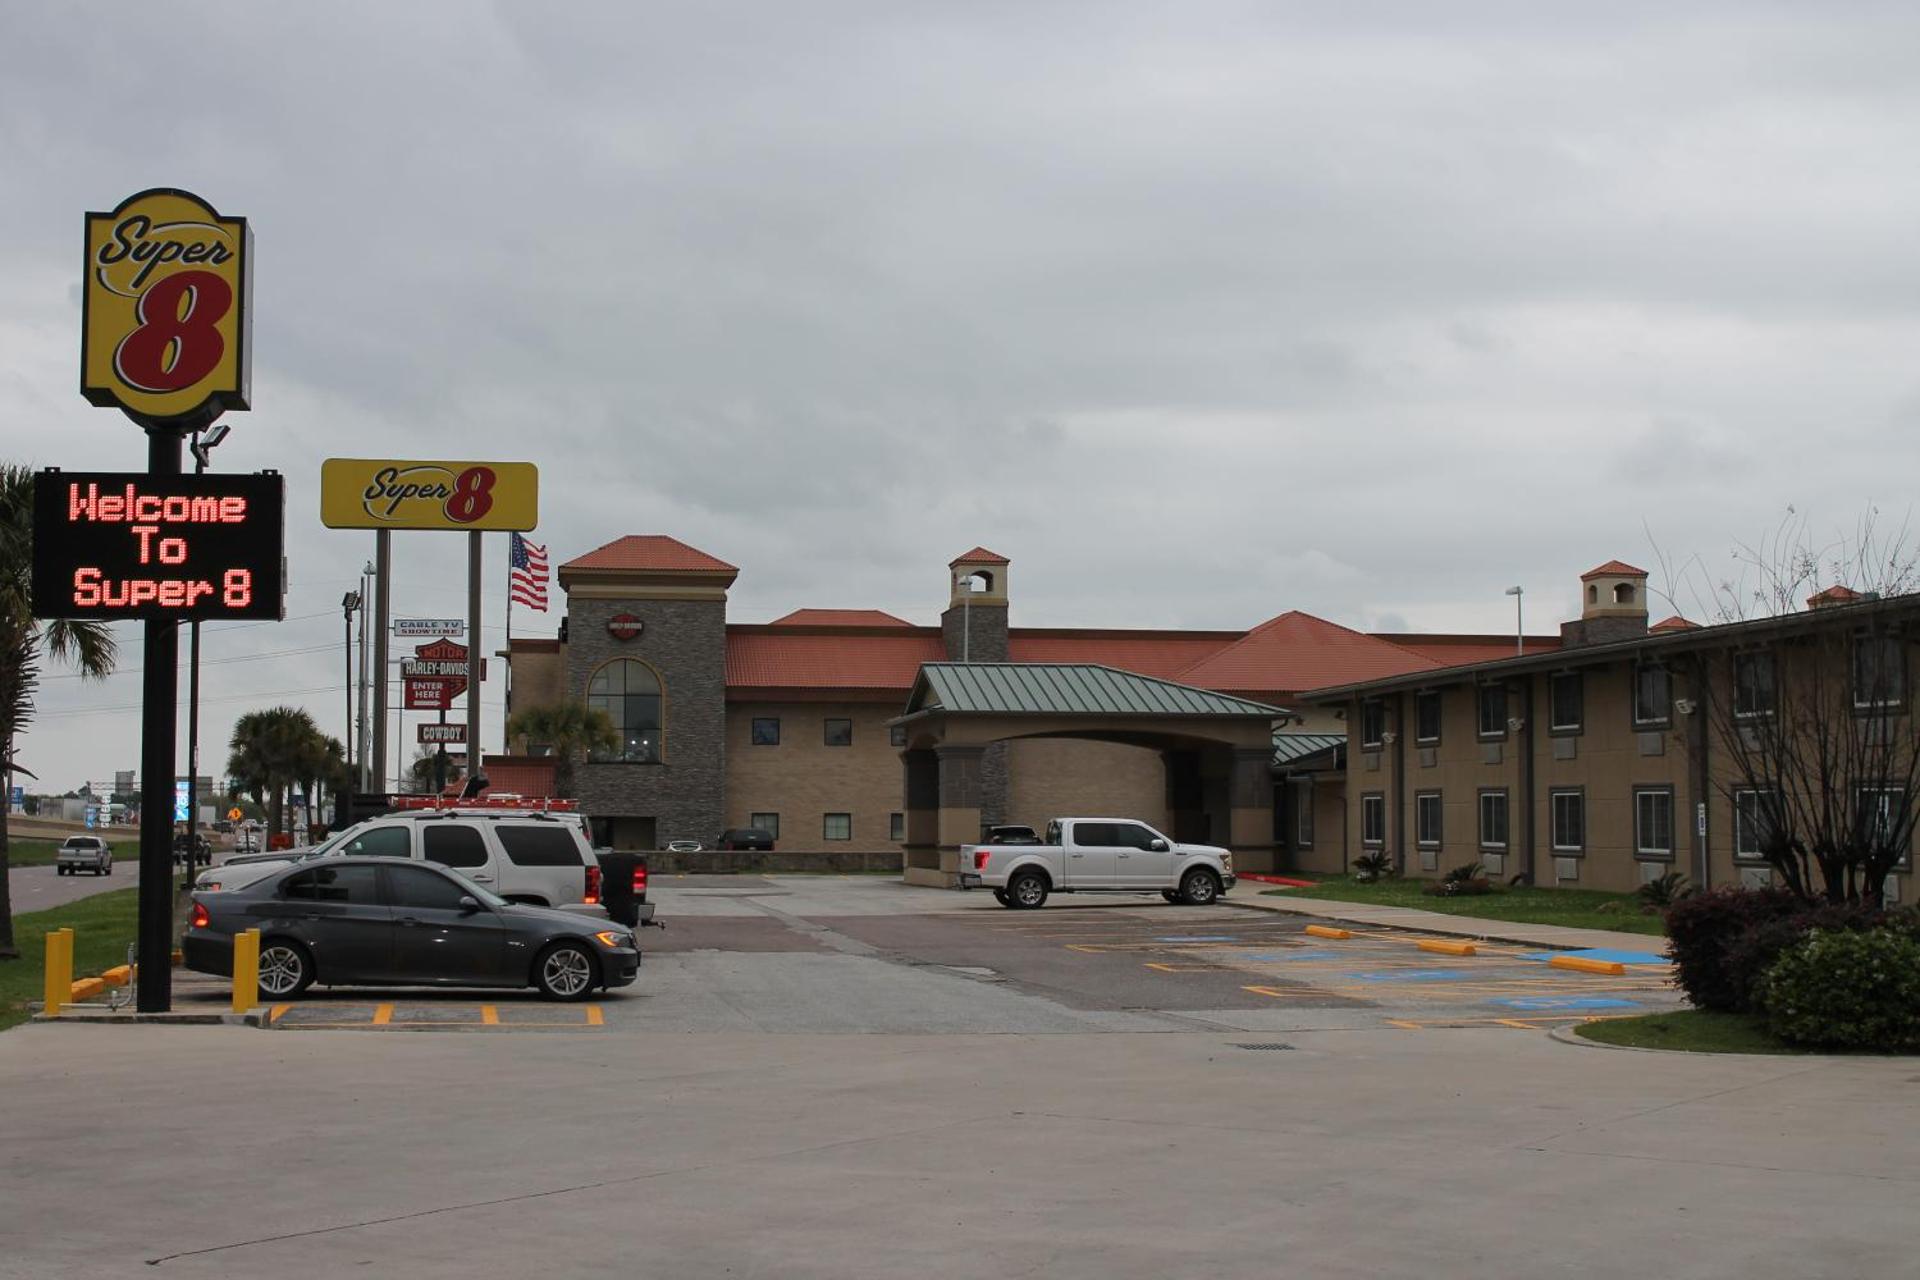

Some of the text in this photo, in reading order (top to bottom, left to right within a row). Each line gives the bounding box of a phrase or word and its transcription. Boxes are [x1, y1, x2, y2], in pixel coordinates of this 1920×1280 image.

[99, 214, 235, 289] Super
[111, 269, 233, 395] 8
[69, 483, 247, 522] Welcome
[364, 465, 497, 524] Super 8
[132, 525, 188, 564] To
[74, 567, 251, 607] Super 8
[406, 661, 469, 675] HARLEY-DAVIDS
[412, 682, 443, 690] ENTER
[415, 690, 441, 699] HERE
[423, 726, 462, 740] COWBOY
